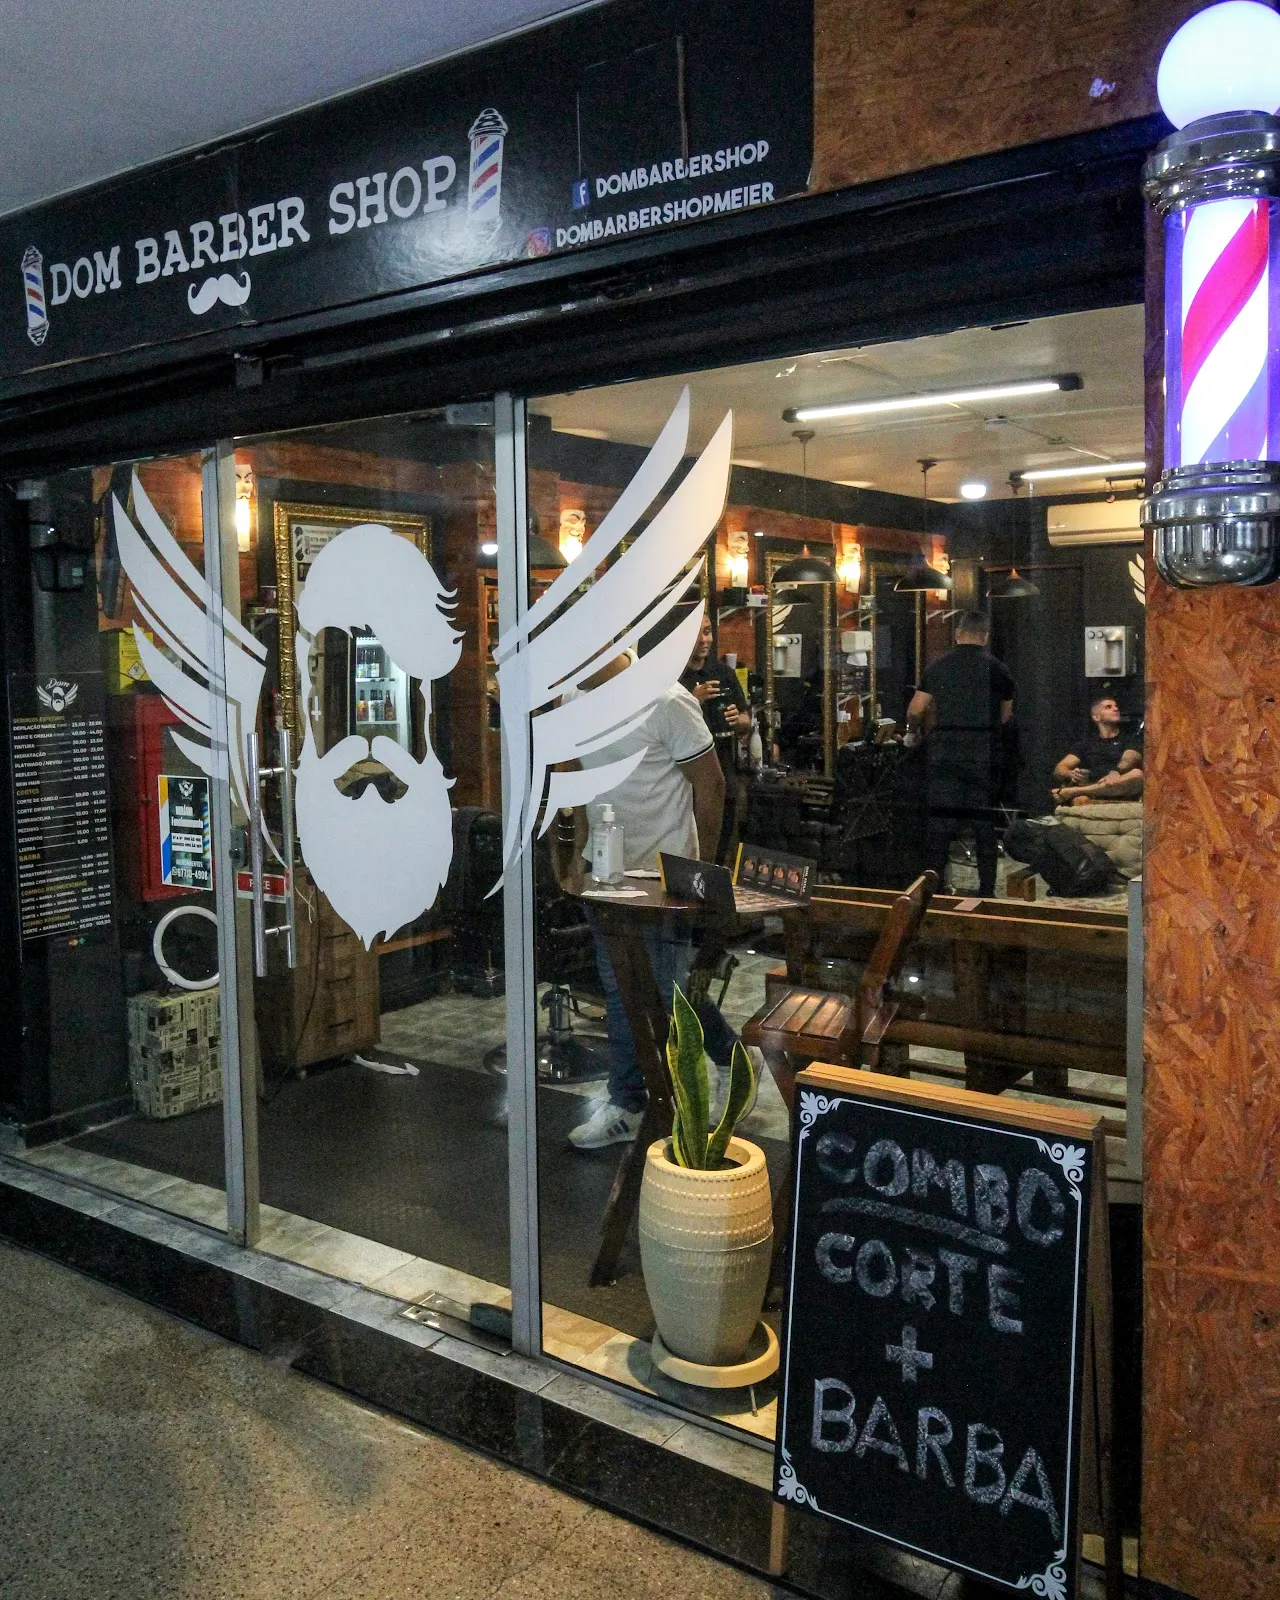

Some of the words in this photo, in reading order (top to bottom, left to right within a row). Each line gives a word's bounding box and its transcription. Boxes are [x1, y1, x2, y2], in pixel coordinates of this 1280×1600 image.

[557, 182, 775, 247] DOMBARBERSHOPMEIER
[596, 139, 769, 198] DOMBARBERSHOP
[50, 246, 121, 306] DOM
[135, 196, 310, 284] BARBER
[329, 156, 456, 234] SHOP
[46, 678, 70, 689] Dom
[816, 1132, 1065, 1247] COMBO
[815, 1231, 1024, 1332] CORTE
[812, 1377, 1063, 1540] BARBA
